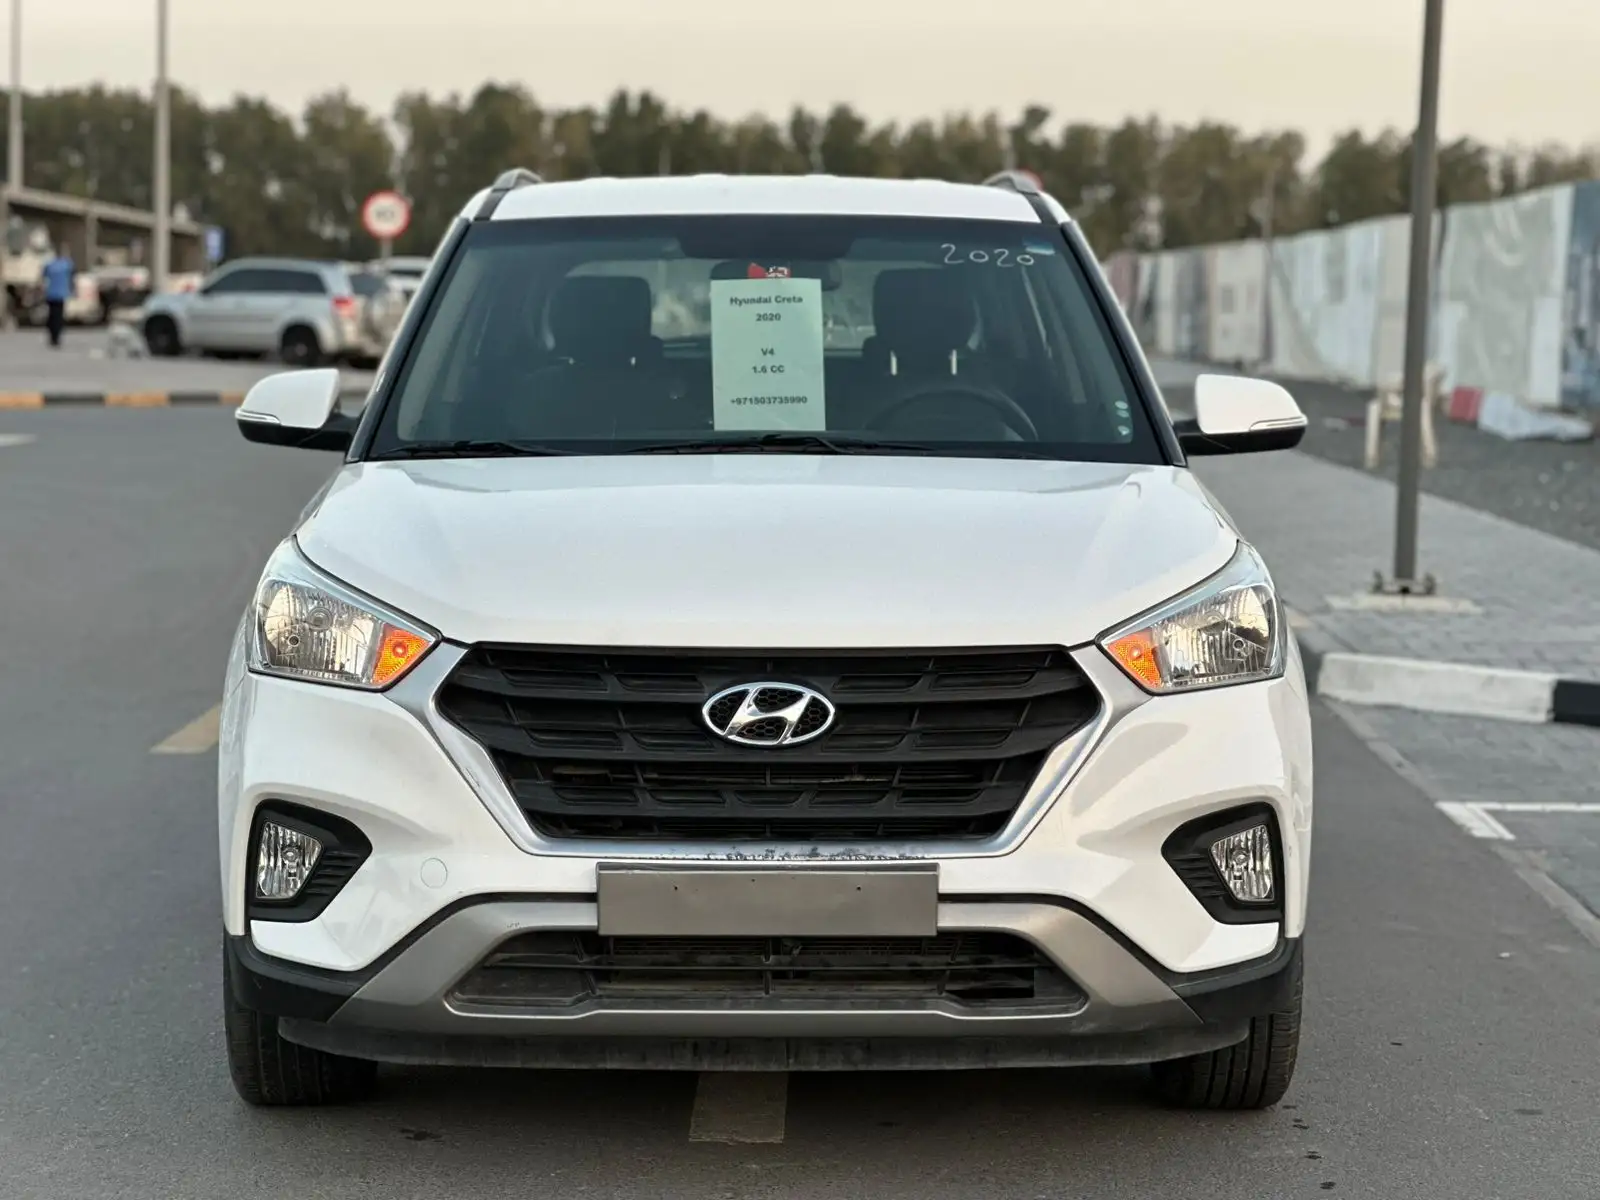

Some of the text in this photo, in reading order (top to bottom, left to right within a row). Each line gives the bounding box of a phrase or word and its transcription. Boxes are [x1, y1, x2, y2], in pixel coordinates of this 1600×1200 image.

[941, 243, 1034, 267] 2020
[729, 294, 803, 307] Hyundai Creta
[755, 313, 781, 321] 2020
[761, 348, 775, 356] V4
[752, 365, 785, 373] 1.6 CC
